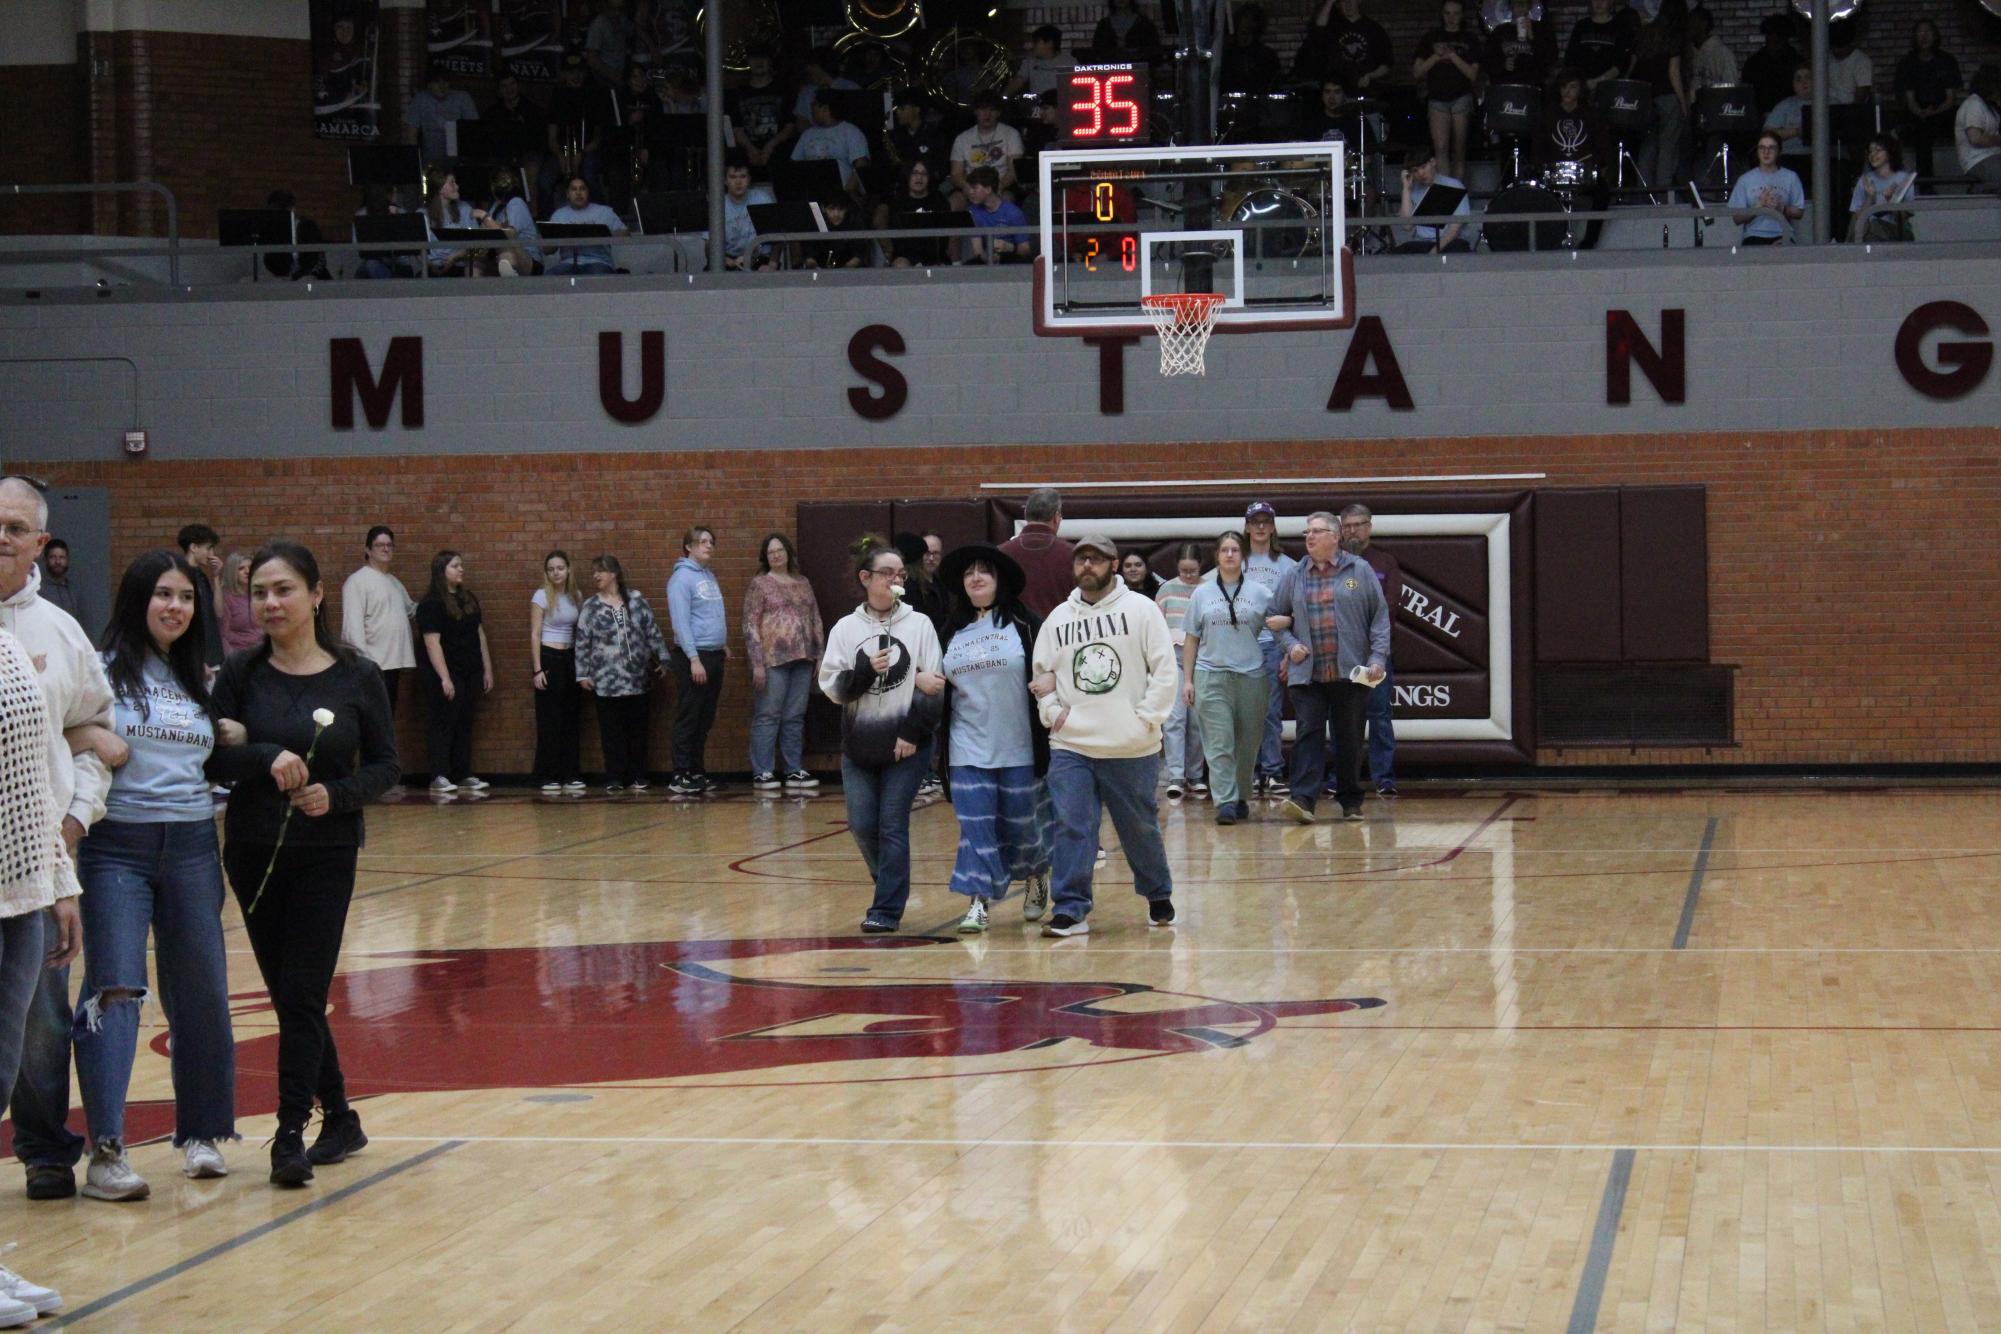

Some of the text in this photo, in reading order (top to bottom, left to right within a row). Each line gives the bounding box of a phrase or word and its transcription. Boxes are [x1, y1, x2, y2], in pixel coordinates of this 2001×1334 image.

[1074, 63, 1133, 72] DAKTRONICS
[1072, 75, 1138, 136] 35
[1056, 612, 1129, 648] NIRVANA
[951, 658, 1008, 677] MUSTANG BAND
[1390, 685, 1450, 707] NGS
[126, 725, 213, 750] MUSTANG BAND
